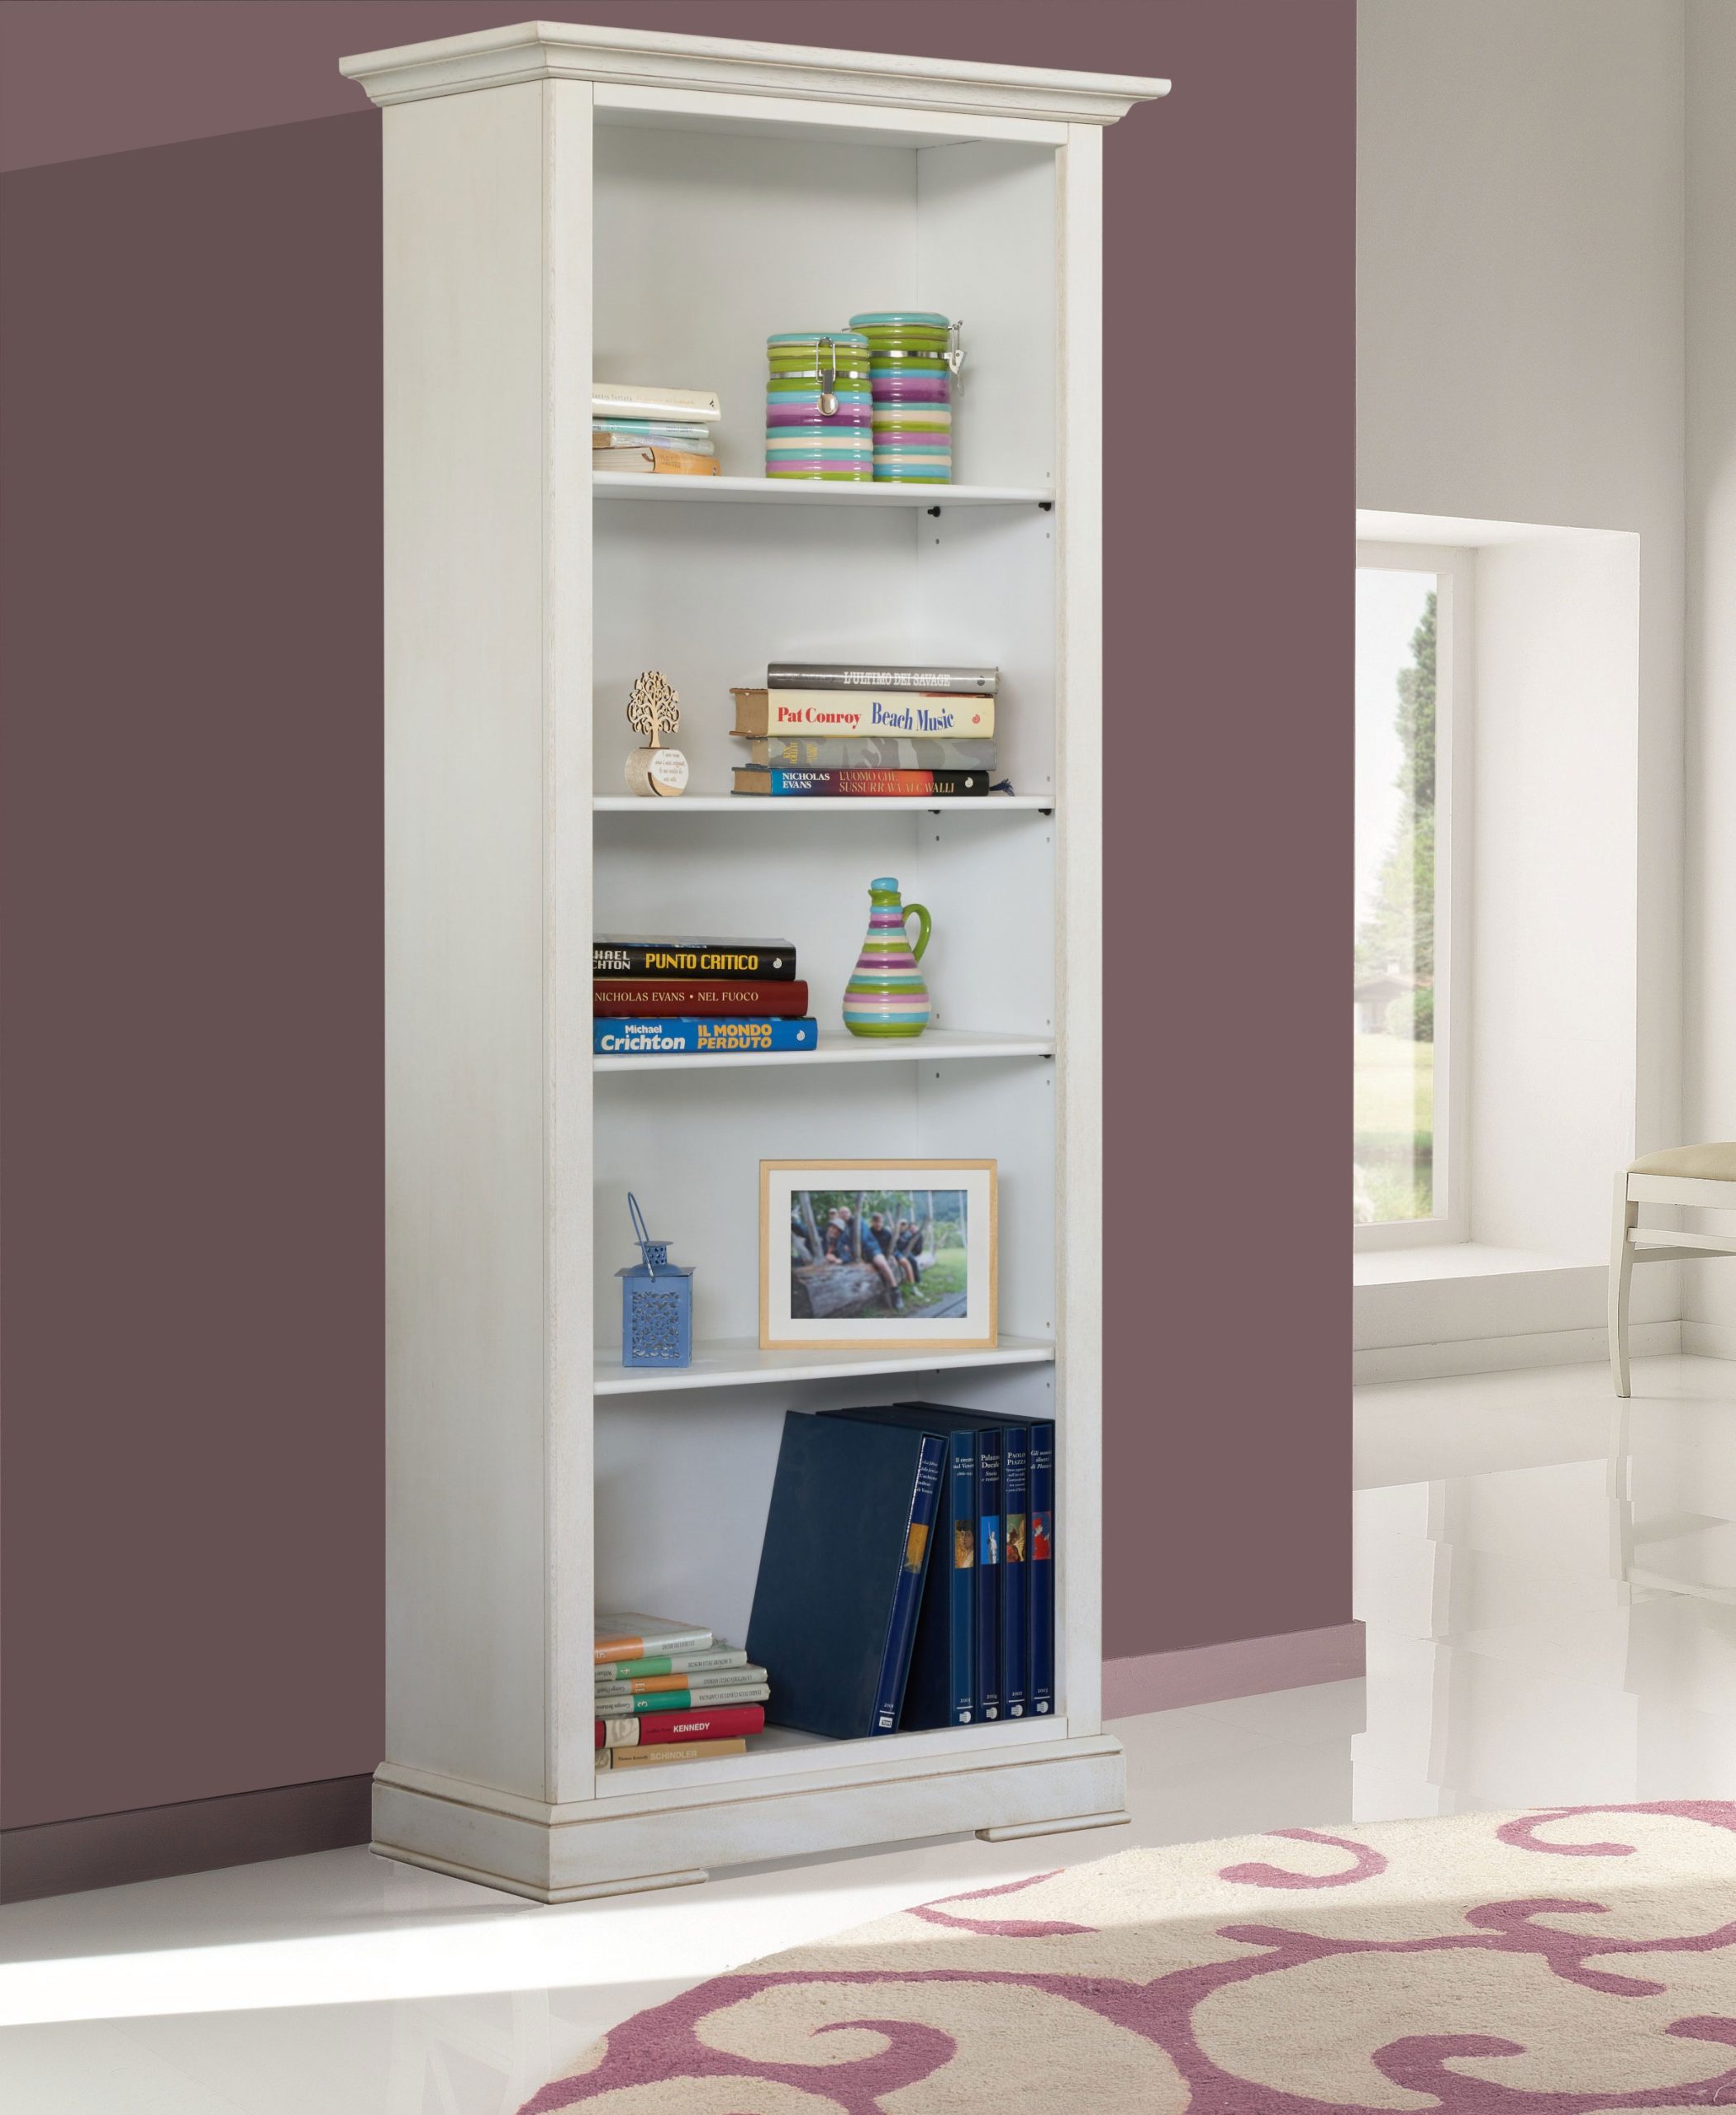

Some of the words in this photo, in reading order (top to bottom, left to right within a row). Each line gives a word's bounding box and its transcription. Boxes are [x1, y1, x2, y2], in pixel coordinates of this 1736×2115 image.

[844, 671, 892, 686] L'ULTIMO
[893, 672, 911, 687] DEI
[913, 673, 950, 687] SAVAGE
[778, 706, 804, 723] Pat
[806, 707, 862, 730] Conroy
[872, 702, 913, 730] Beach
[916, 708, 955, 732] Music
[839, 772, 876, 781] L'UOMO
[878, 772, 897, 782] CHE
[782, 781, 812, 789] EVANS
[645, 953, 697, 969] PUNTO
[701, 954, 759, 970] CRITICO
[594, 992, 649, 1001] NICHOLAS
[652, 992, 685, 1001] EVANS
[697, 992, 719, 1001] NEL
[721, 992, 759, 1001] FUOCO
[625, 1024, 662, 1034] Michael
[697, 1024, 711, 1037] IL
[714, 1024, 773, 1037] MONDO
[601, 1034, 686, 1051] Crichton
[697, 1037, 773, 1049] PERDUTO
[673, 1723, 711, 1733] KENNEDY
[649, 1750, 697, 1761] SCHINDLER
